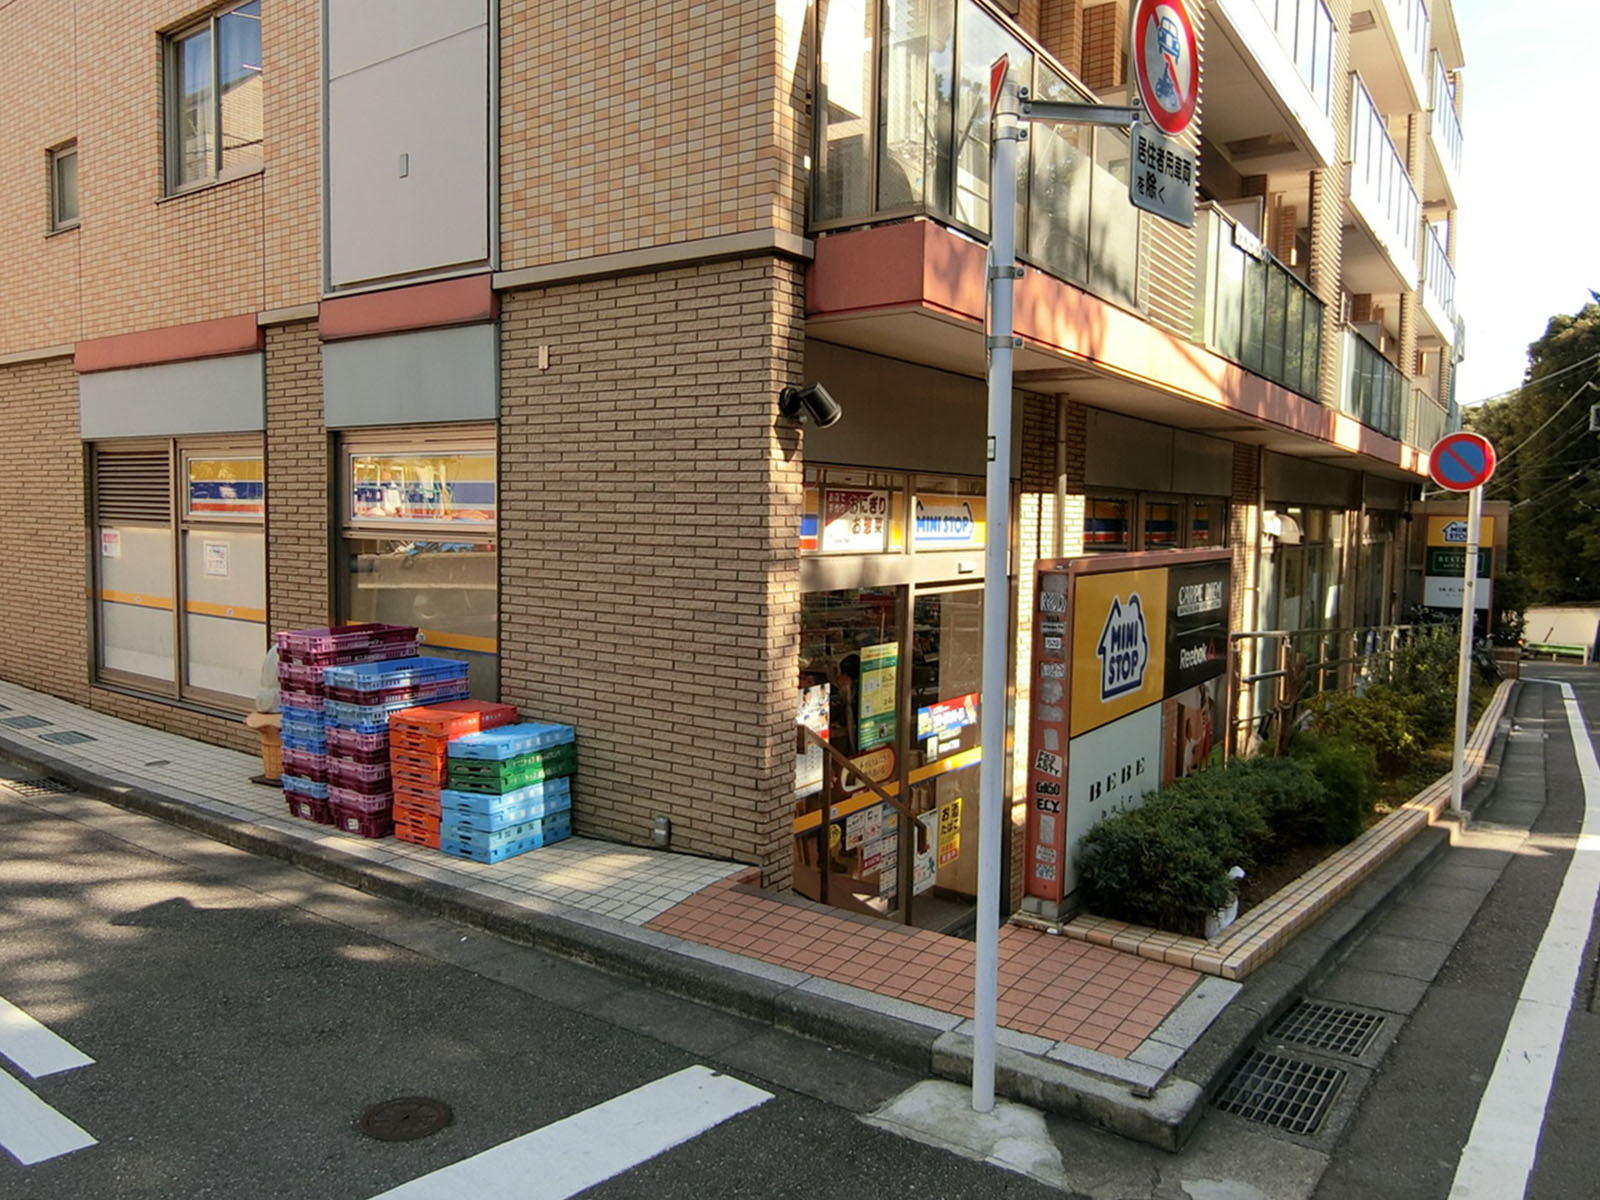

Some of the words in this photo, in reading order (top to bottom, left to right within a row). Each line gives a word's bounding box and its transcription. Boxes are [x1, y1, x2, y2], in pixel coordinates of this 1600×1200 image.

[1139, 135, 1192, 187] 居住者用車両
[1137, 170, 1165, 205] を除く
[849, 495, 886, 515] おにぎり
[916, 514, 942, 533] MINI
[943, 515, 969, 533] STOP
[1111, 620, 1139, 653] MINI
[1108, 650, 1139, 685] STOP
[1180, 643, 1207, 670] Reebok
[1089, 757, 1145, 802] BEBE
